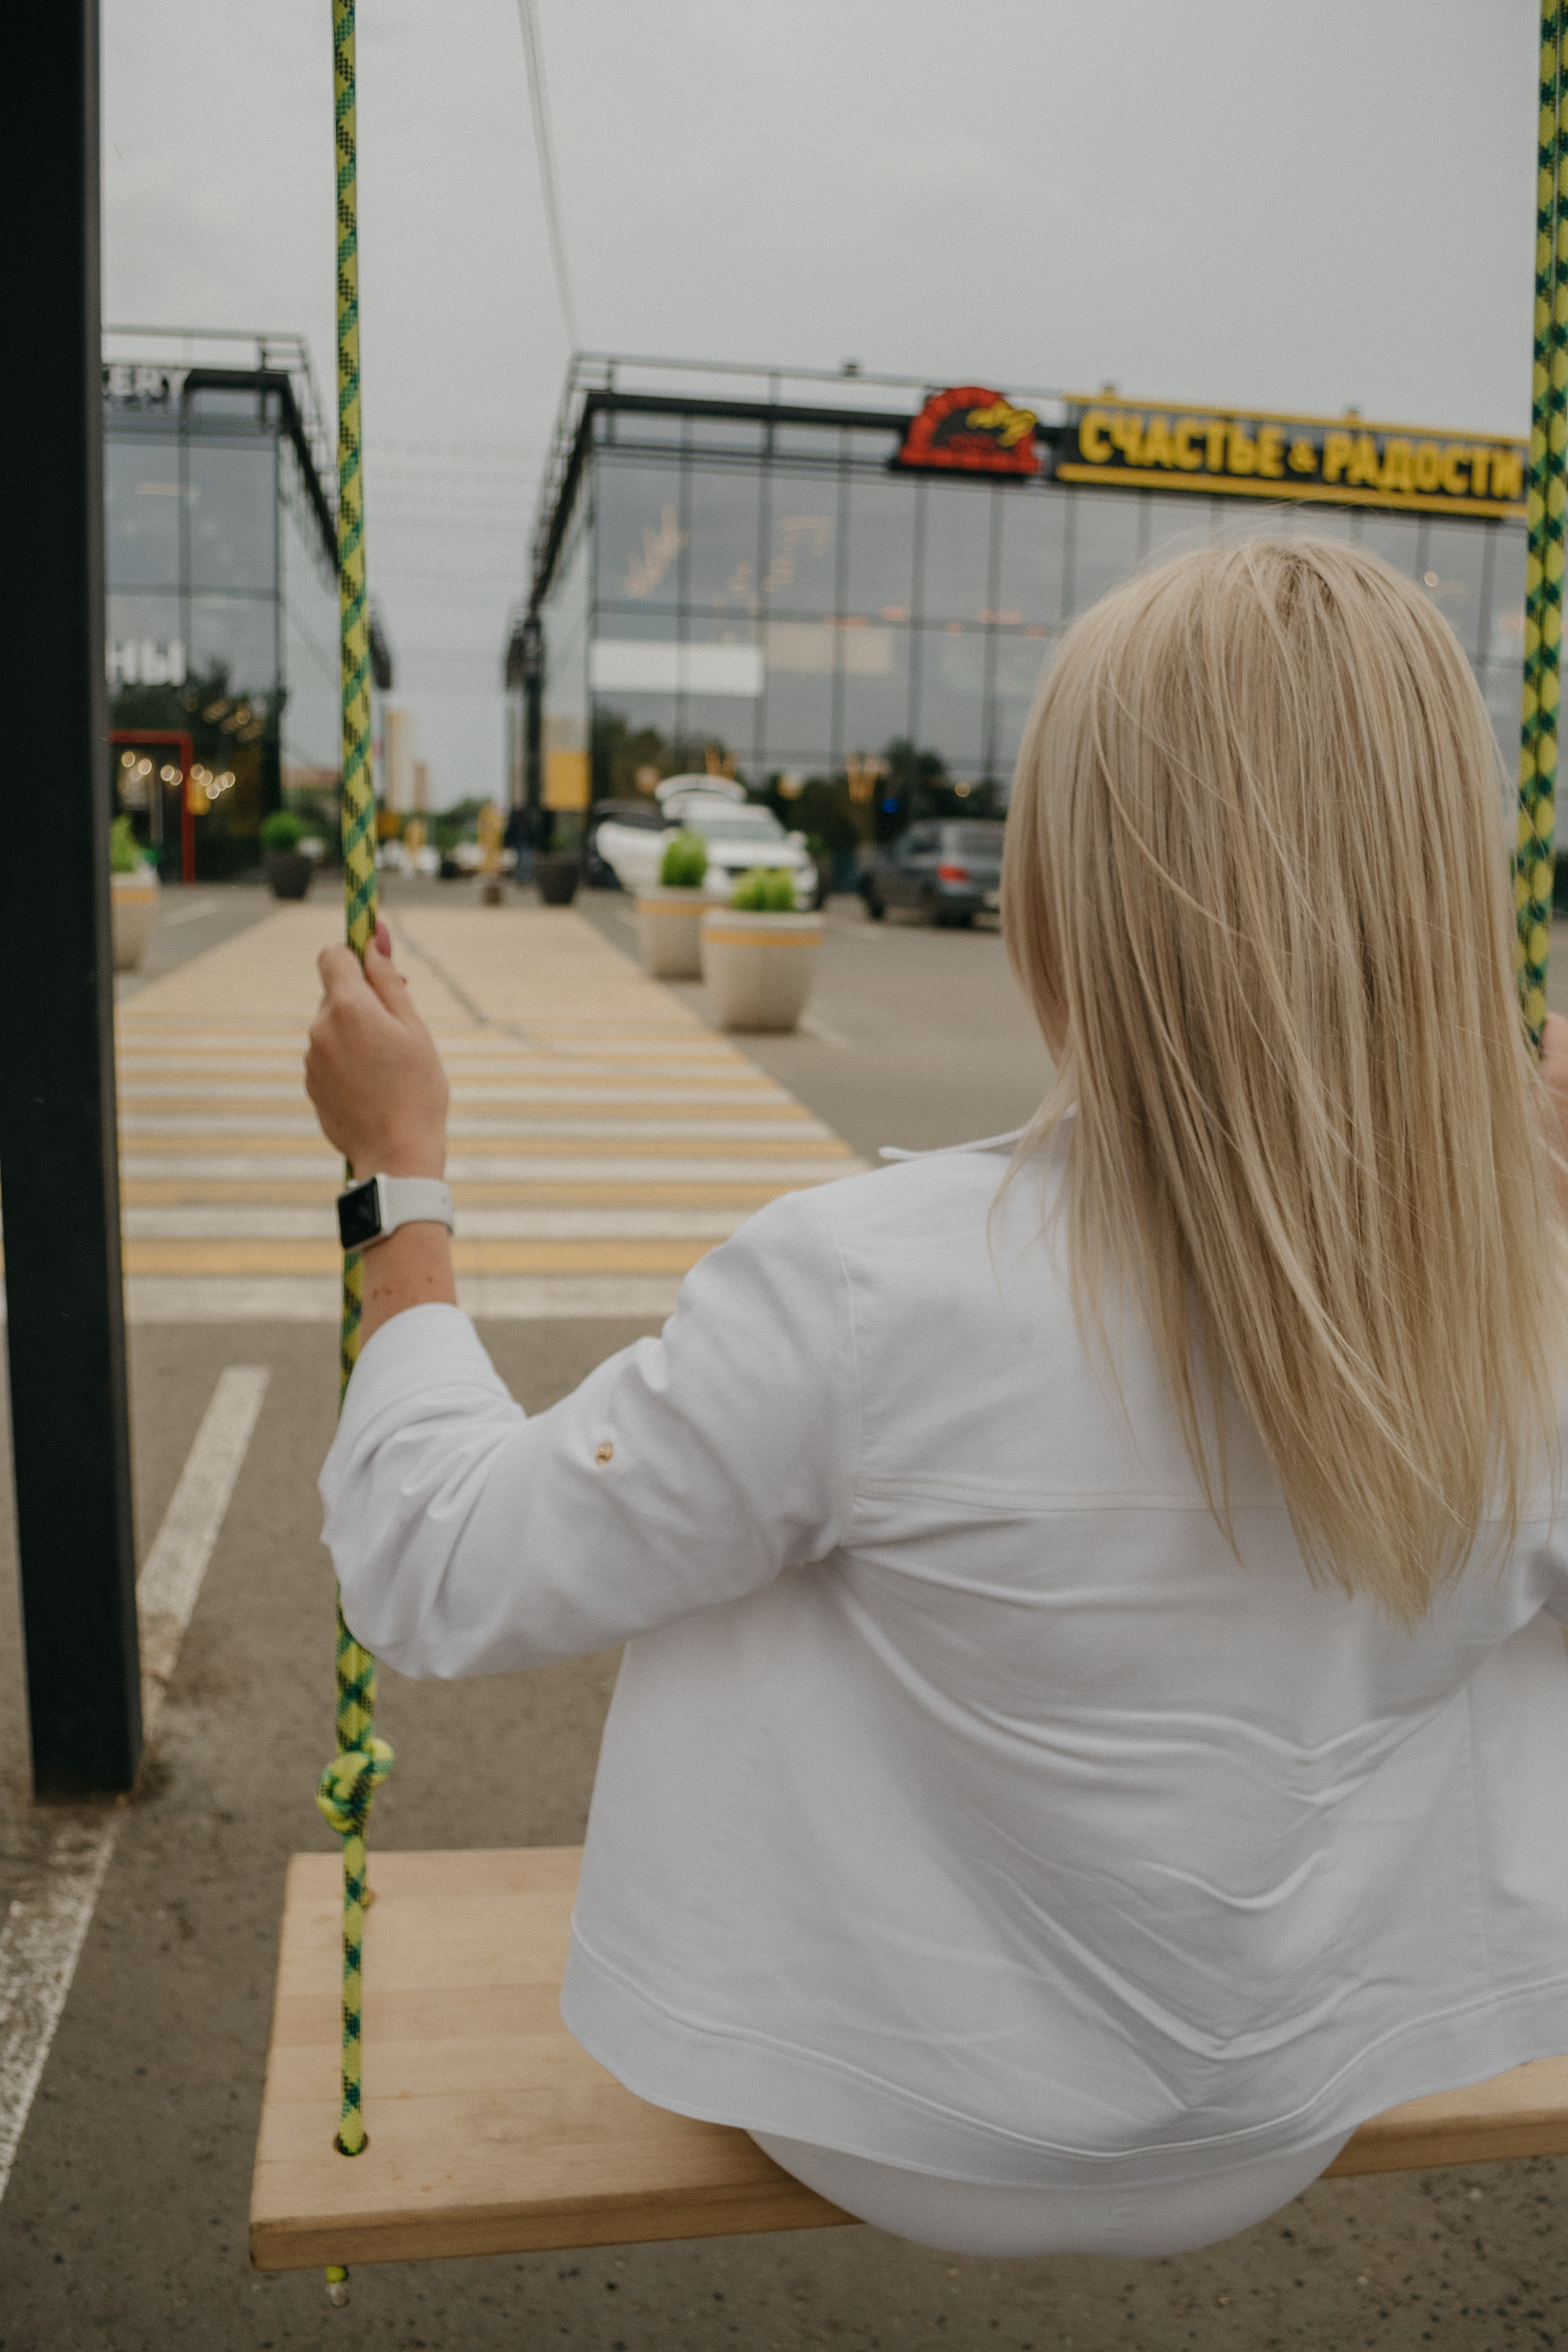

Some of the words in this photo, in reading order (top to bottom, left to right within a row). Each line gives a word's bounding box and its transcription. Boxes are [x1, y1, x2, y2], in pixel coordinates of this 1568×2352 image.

[103, 364, 190, 399] ERY
[1079, 408, 1286, 479] СЧАСТЬЕ
[1322, 431, 1523, 499] РАДОСТИ
